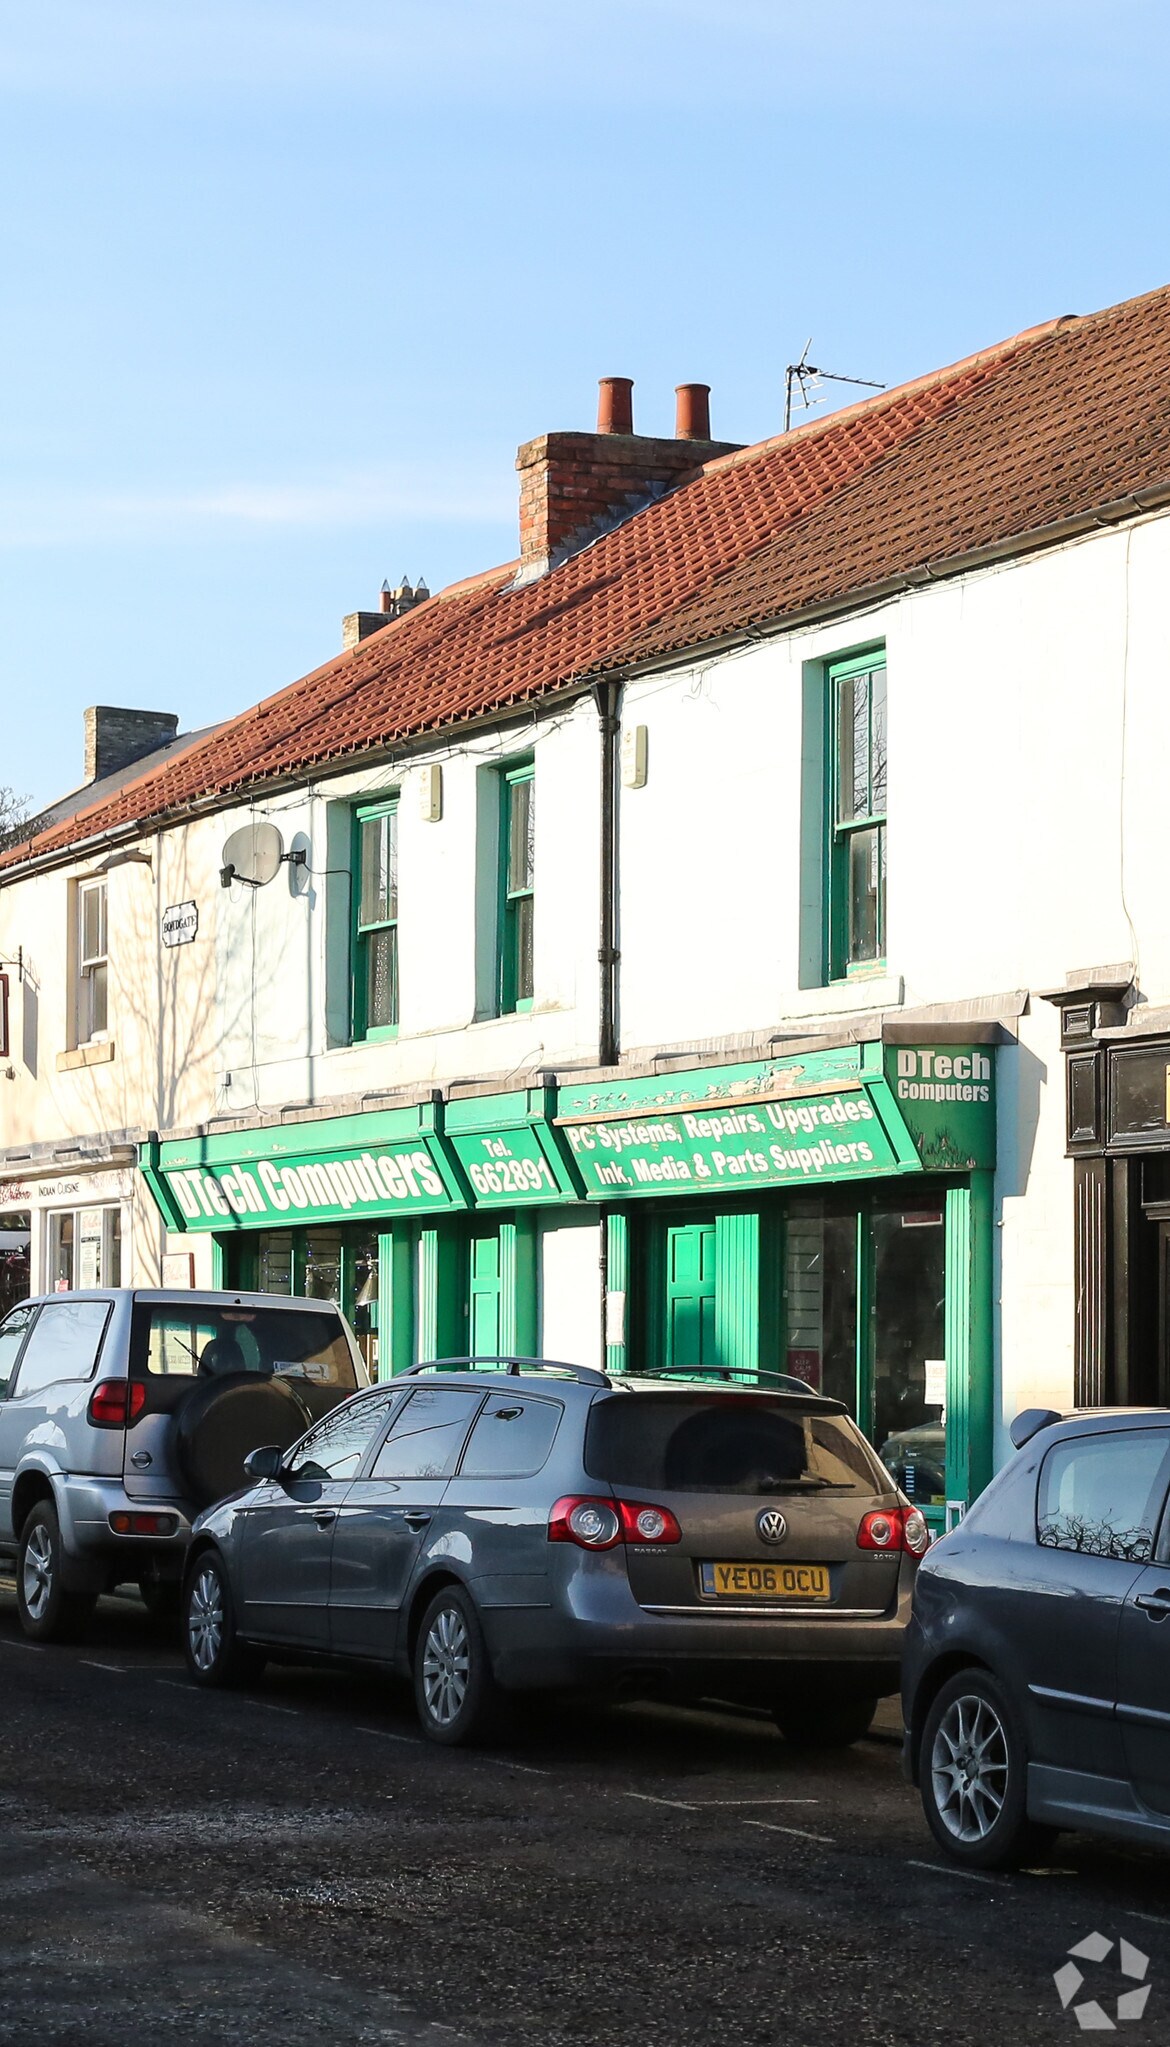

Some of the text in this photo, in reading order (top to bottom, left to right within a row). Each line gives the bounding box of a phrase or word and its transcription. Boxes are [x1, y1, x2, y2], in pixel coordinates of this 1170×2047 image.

[163, 915, 197, 933] BONDGATE
[897, 1049, 990, 1080] DTech
[897, 1079, 990, 1102] Computers
[567, 1097, 874, 1153] PC Systems, Repairs, Upgrades
[481, 1137, 512, 1158] Tel.
[594, 1139, 874, 1187] Ink, Media & Parts Suppliers
[167, 1151, 445, 1219] DTech Computers
[469, 1156, 556, 1194] 662891
[718, 1566, 824, 1593] YE06 OCU
